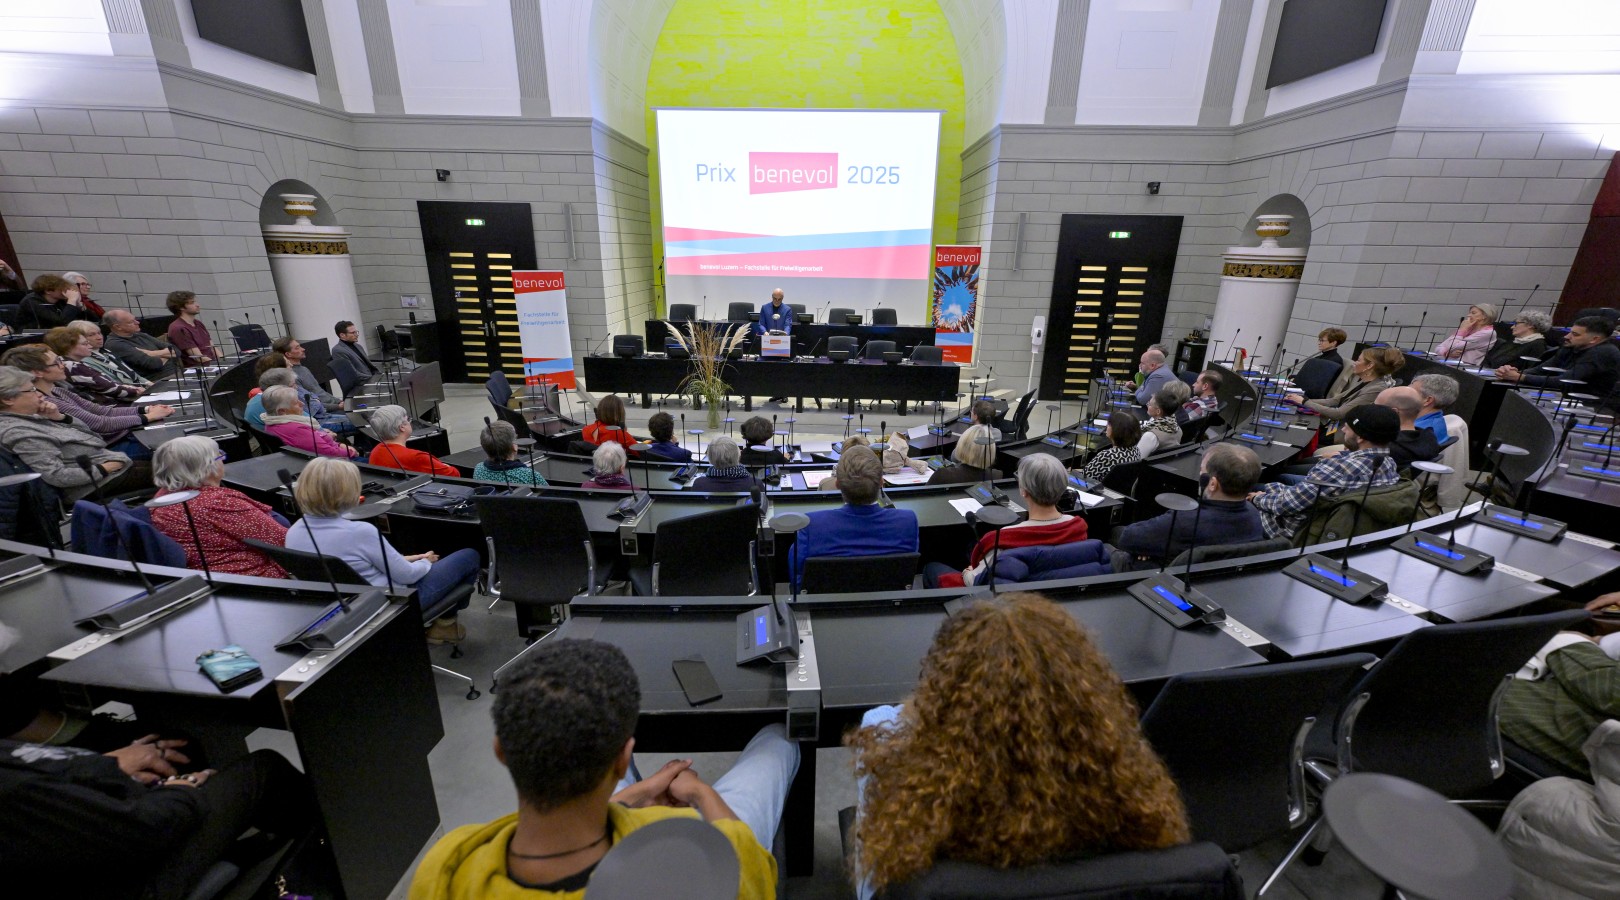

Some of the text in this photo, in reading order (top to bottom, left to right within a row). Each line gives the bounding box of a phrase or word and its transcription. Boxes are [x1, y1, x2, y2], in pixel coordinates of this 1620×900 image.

[696, 163, 900, 185] Prix benevol 2025
[936, 252, 980, 262] benevol
[514, 277, 563, 288] benevol
